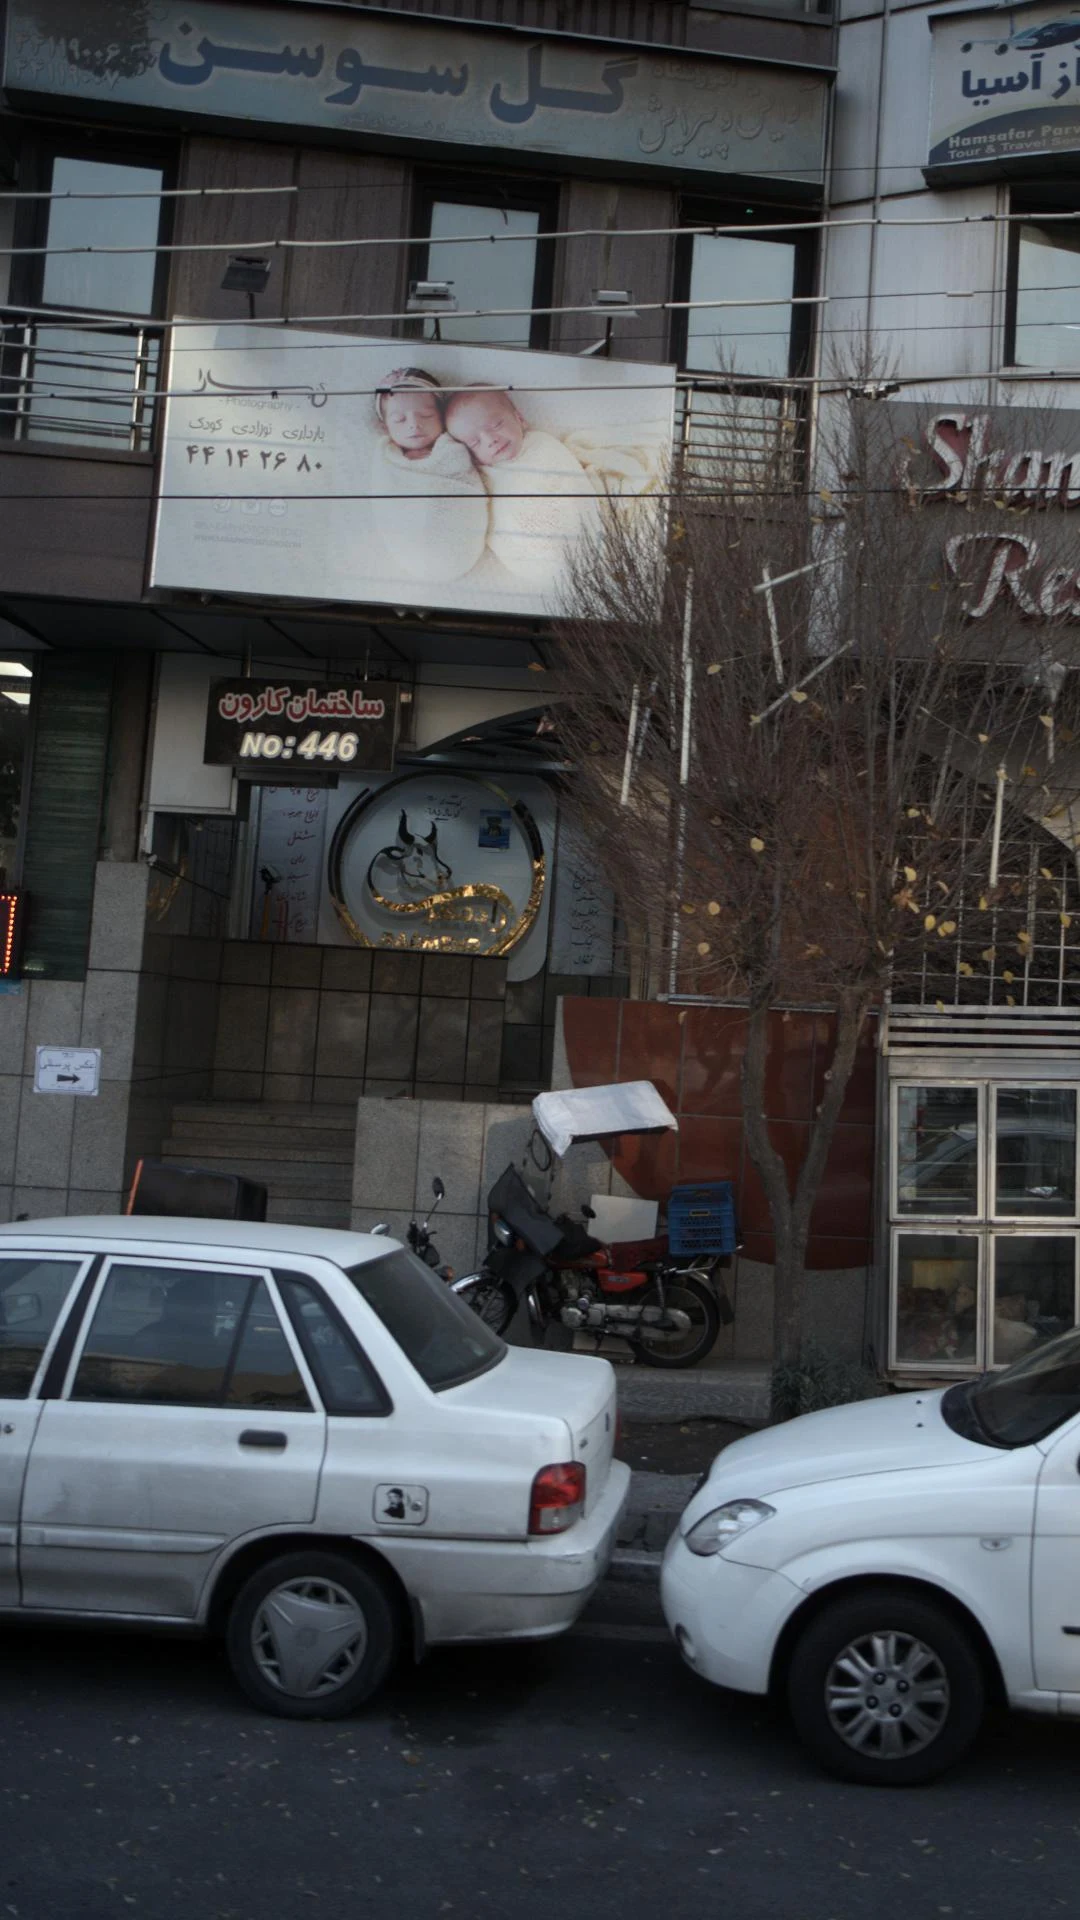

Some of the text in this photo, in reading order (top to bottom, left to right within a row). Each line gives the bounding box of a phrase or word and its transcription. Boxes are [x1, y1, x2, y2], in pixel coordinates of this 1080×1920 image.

[158, 21, 469, 106] سوسن
[489, 43, 640, 124] گل
[962, 52, 1046, 106] آسیا
[947, 128, 1035, 149] Hamsafar
[947, 147, 981, 160] Tour
[984, 144, 996, 154] &
[1001, 138, 1047, 152] Travel
[188, 417, 326, 442] بارداری نوزادی کودک
[946, 532, 1080, 618] Re
[219, 686, 385, 723] ساختمان کارون
